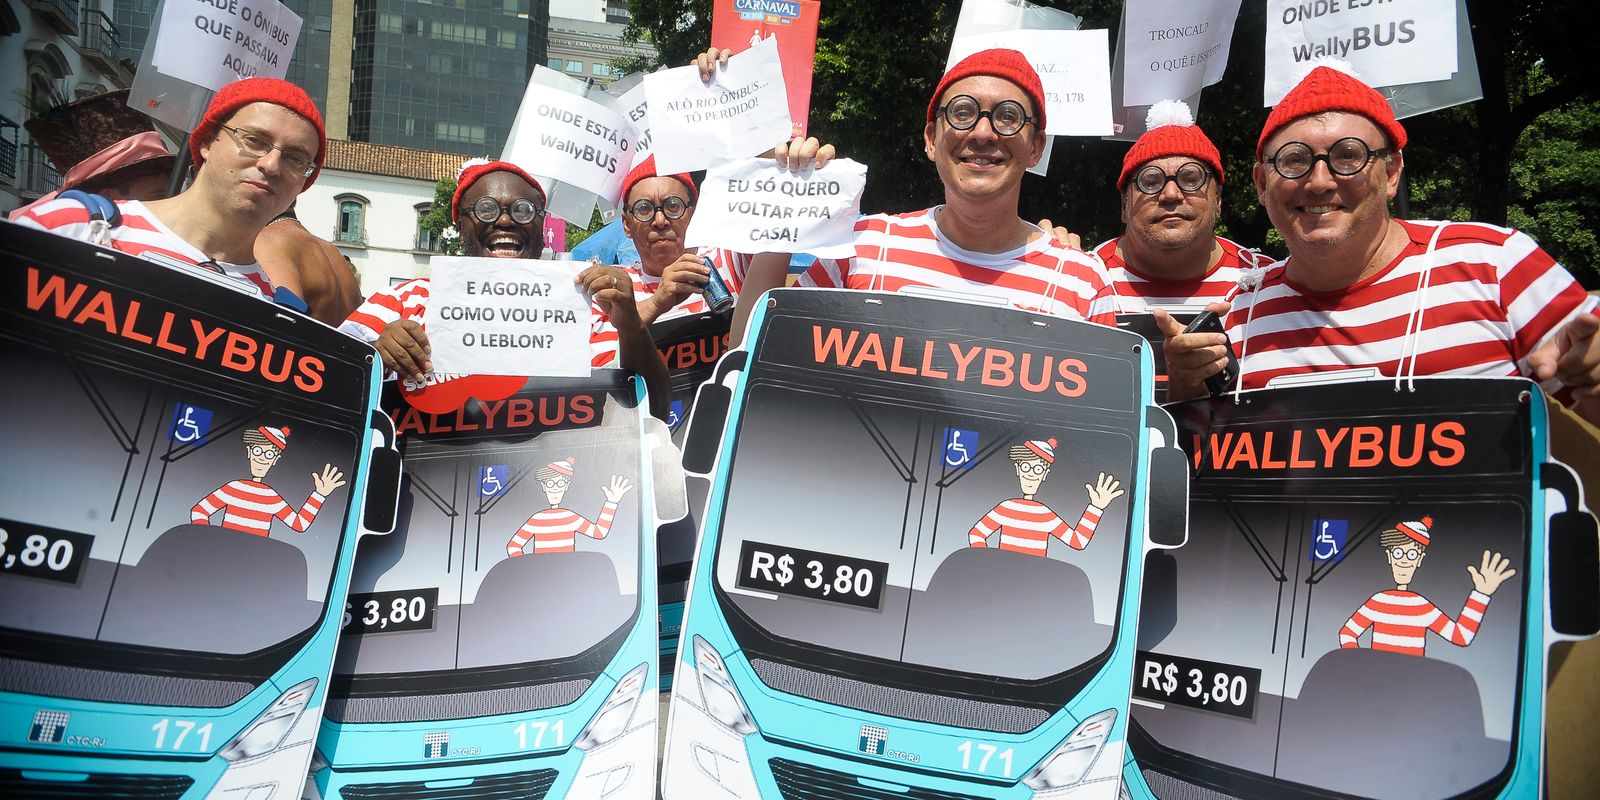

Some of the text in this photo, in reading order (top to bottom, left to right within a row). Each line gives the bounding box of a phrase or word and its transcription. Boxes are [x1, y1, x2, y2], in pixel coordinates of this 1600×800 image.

[736, 0, 797, 16] CARNAVAL
[1282, 0, 1340, 24] ONDE
[241, 6, 252, 21] O
[254, 11, 290, 46] ÔNIBUS
[1149, 22, 1209, 40] TRONCAL?
[195, 15, 278, 68] QUE PASSAVA
[1292, 19, 1416, 62] WallyBUS
[223, 53, 257, 77] AQUI?
[1150, 61, 1160, 72] O
[1164, 56, 1188, 72] QUÊ
[666, 98, 692, 112] ALÔ
[696, 97, 717, 108] RIO
[684, 97, 759, 124] TÔ PERDIDO!
[1066, 92, 1084, 102] 178
[537, 104, 583, 128] ONDE
[585, 119, 618, 145] ESTÁ
[620, 138, 629, 152] O
[540, 133, 618, 174] WallyBUS
[727, 177, 840, 198] EU SÓ QUERO
[728, 201, 831, 220] VOLTAR PRA
[749, 227, 799, 242] CASA!
[466, 281, 551, 296] E AGORA?
[440, 306, 577, 324] COMO VOU PRA
[26, 266, 326, 392] WALLYBUS
[462, 332, 554, 349] O LEBLON?
[812, 325, 1088, 398] WALLYBUS
[1193, 421, 1466, 472] WALLYBUS
[750, 550, 874, 598] R$ 3,80
[362, 596, 426, 628] 3,80
[1142, 660, 1248, 706] R$ 3,80
[152, 718, 214, 752] 171
[514, 720, 564, 749] 171
[887, 750, 920, 762] CTC-RJ
[957, 740, 1014, 778] 171
